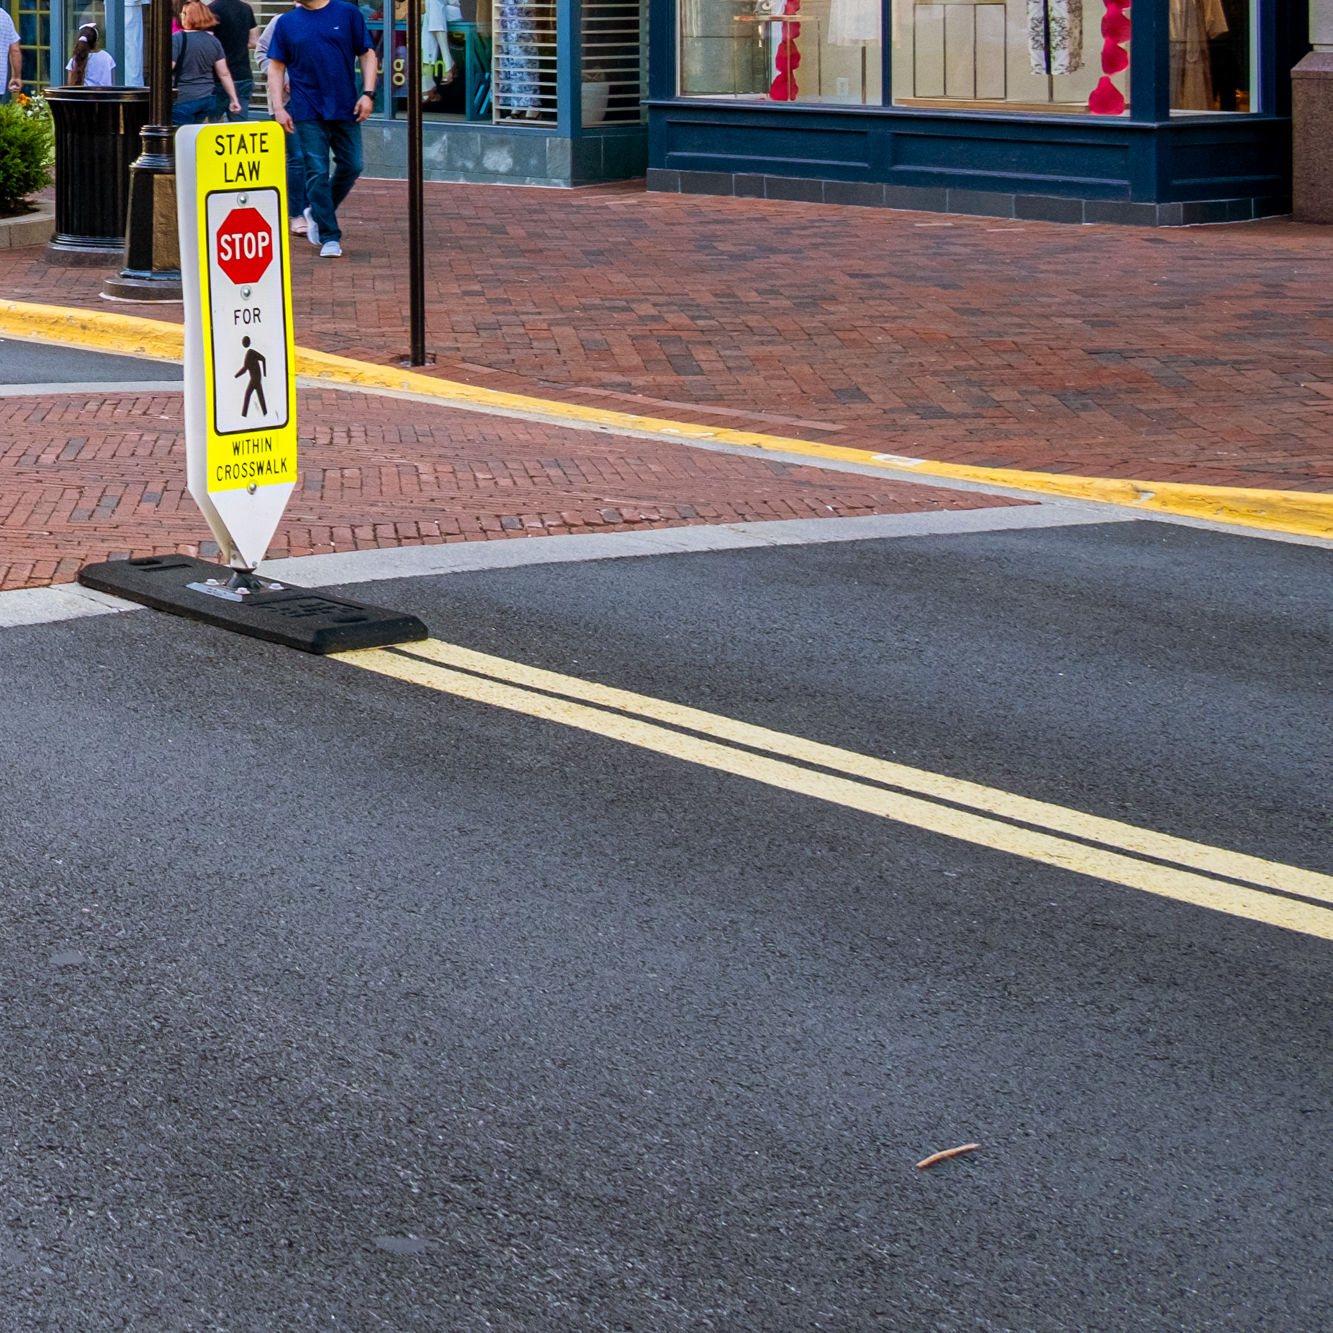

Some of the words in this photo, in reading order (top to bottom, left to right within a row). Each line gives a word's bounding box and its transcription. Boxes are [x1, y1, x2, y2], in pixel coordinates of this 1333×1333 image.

[214, 132, 269, 156] STATE
[224, 160, 260, 183] LAW
[220, 231, 270, 262] STOP
[234, 307, 262, 326] FOR
[232, 436, 272, 456] WITHIN
[216, 457, 288, 482] CROSSWALK
